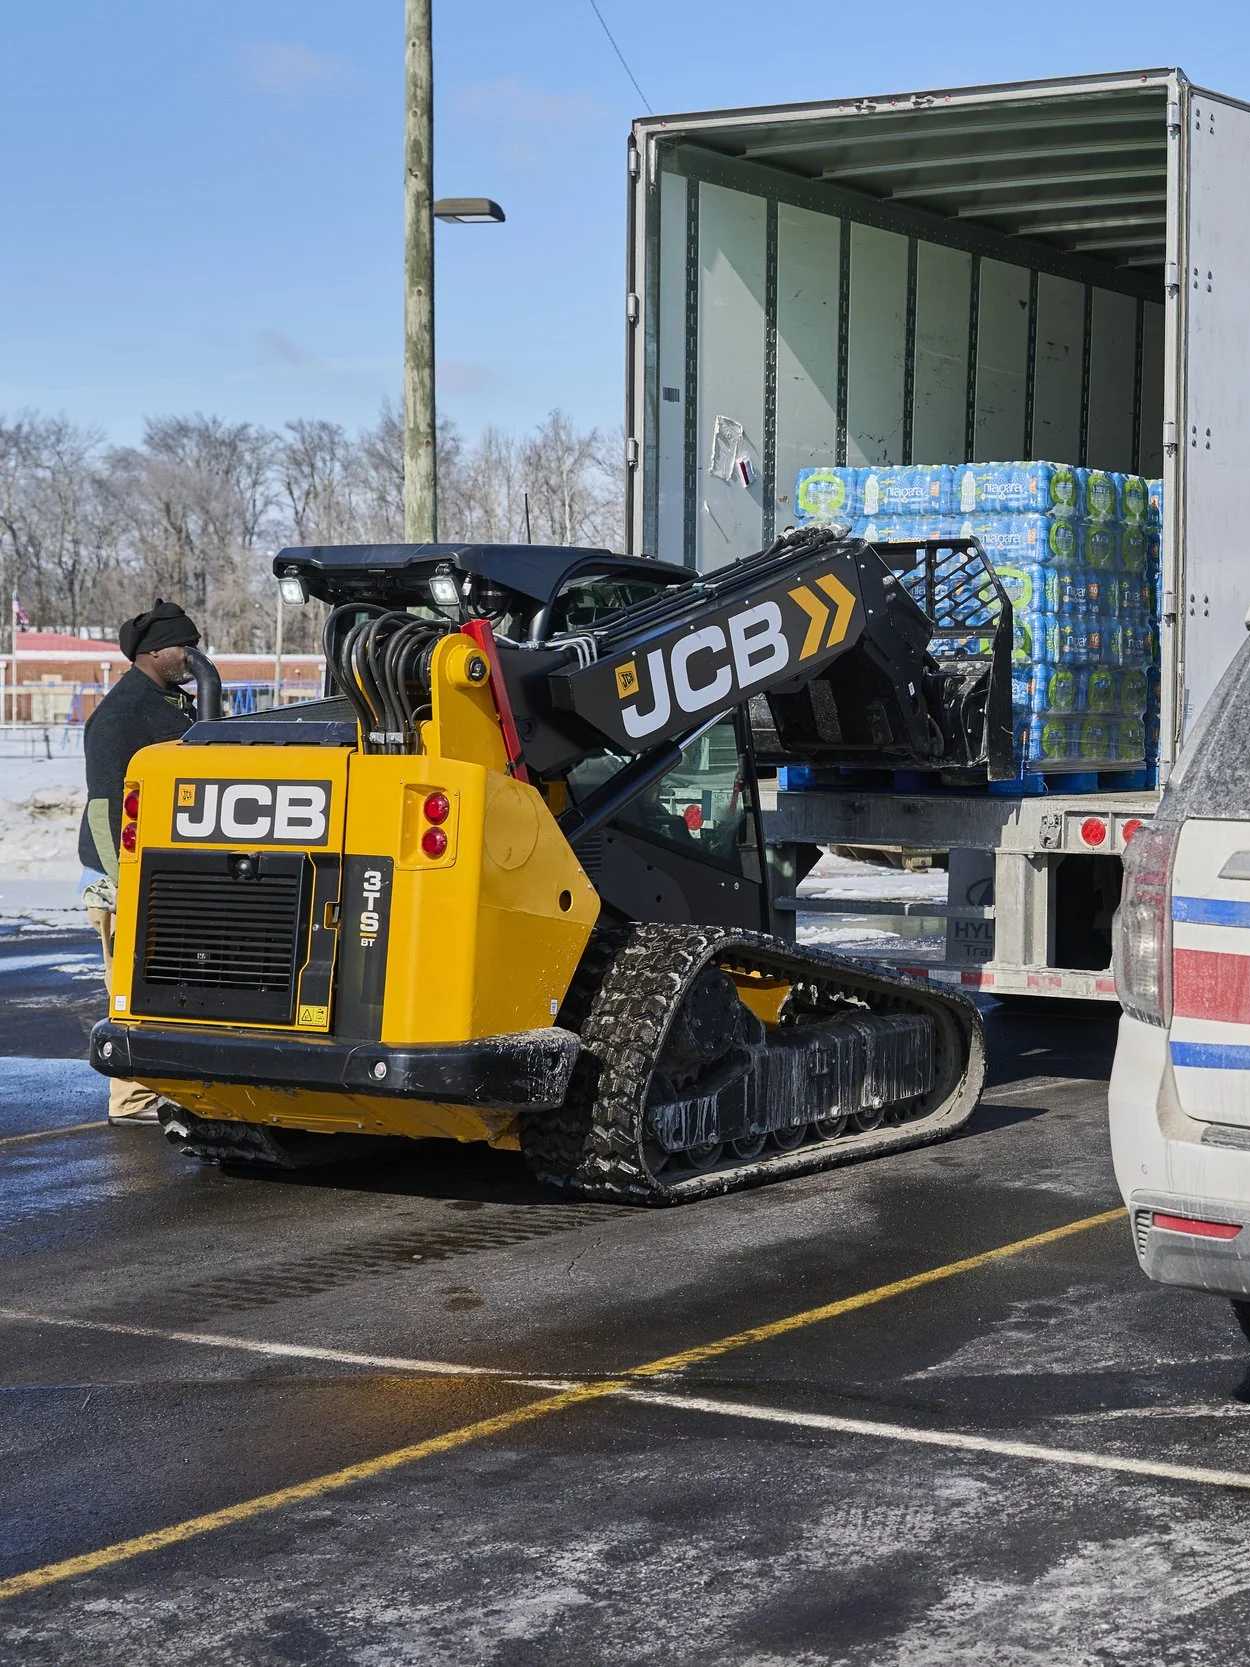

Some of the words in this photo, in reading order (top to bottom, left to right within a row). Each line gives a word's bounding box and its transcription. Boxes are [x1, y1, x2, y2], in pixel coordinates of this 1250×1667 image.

[886, 486, 924, 502] niagara
[984, 482, 1023, 499] niagara
[983, 533, 1020, 549] niagara
[621, 601, 790, 739] JCB
[621, 671, 635, 688] JCB
[176, 784, 326, 840] JCB
[359, 870, 382, 932] 3TS
[360, 938, 376, 947] 8T
